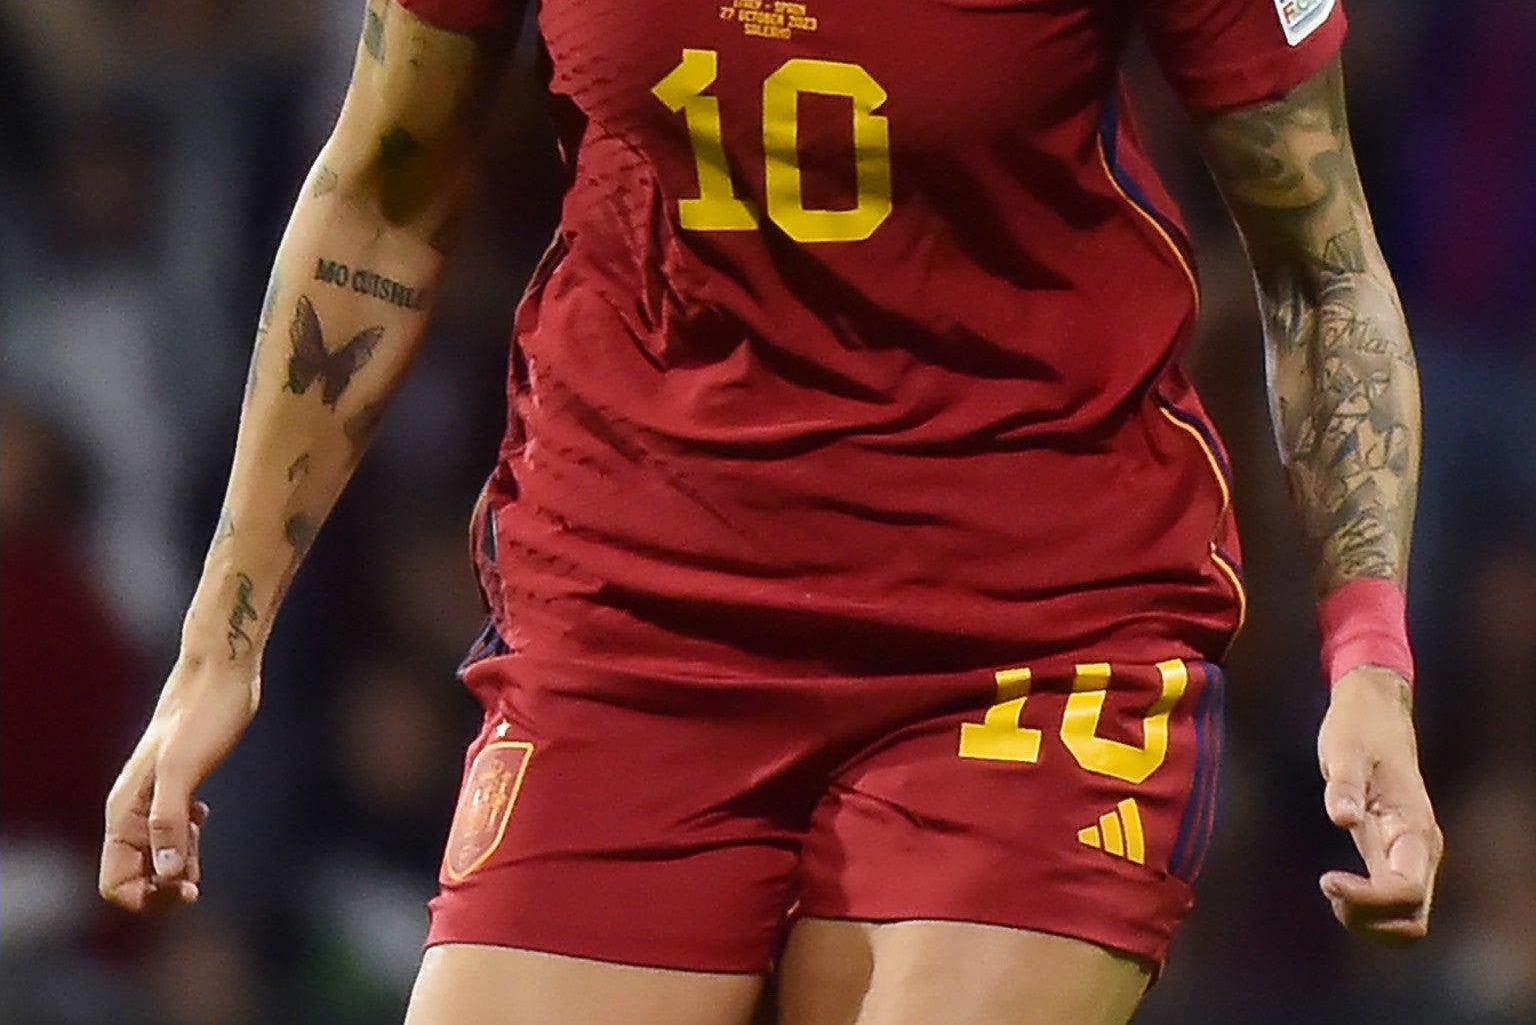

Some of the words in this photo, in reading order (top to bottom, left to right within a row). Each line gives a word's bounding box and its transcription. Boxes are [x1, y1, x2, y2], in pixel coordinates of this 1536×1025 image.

[719, 6, 735, 20] 27
[651, 48, 893, 243] 10
[314, 257, 349, 287] MO
[958, 658, 1188, 785] 10
